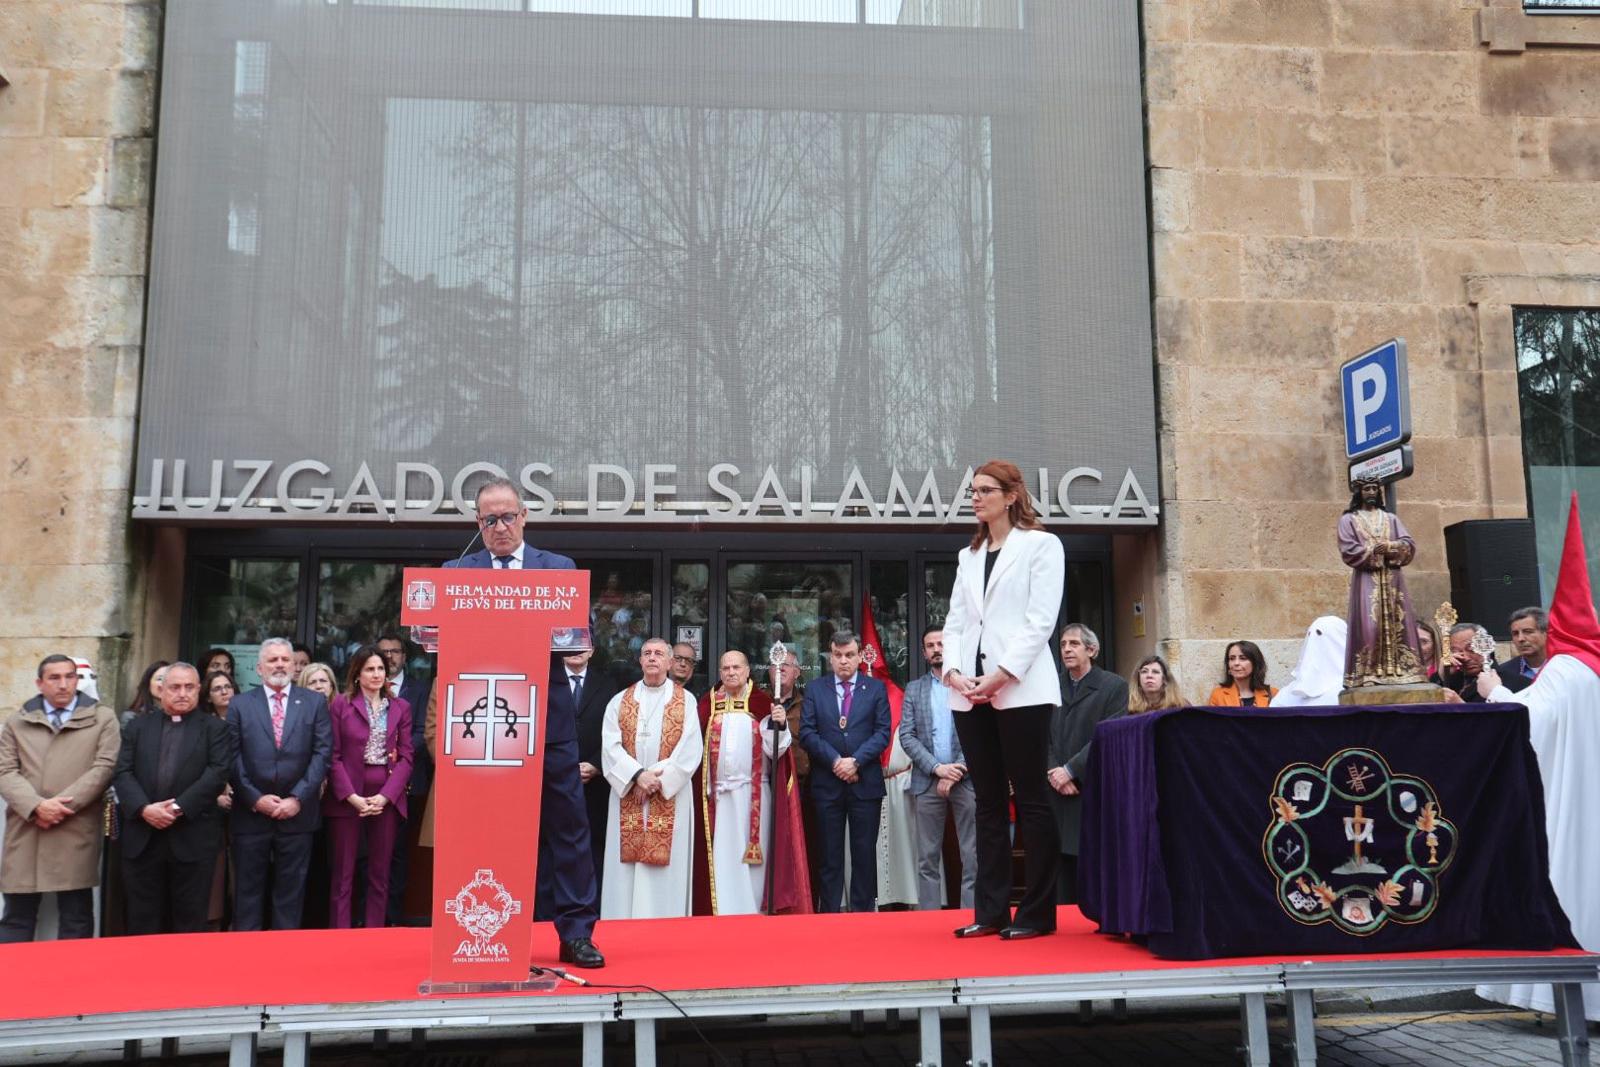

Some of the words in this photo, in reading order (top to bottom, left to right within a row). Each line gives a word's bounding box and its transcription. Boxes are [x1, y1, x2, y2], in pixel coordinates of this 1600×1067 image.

[1352, 362, 1387, 445] P
[133, 459, 555, 516] JUZGADOS
[587, 464, 677, 516] DE
[707, 464, 1157, 520] SALAMANCA
[445, 585, 532, 597] HERMANDAD
[535, 586, 550, 597] DE
[555, 586, 580, 598] N.P.
[494, 599, 515, 609] DEL
[520, 598, 571, 610] PERDÓN
